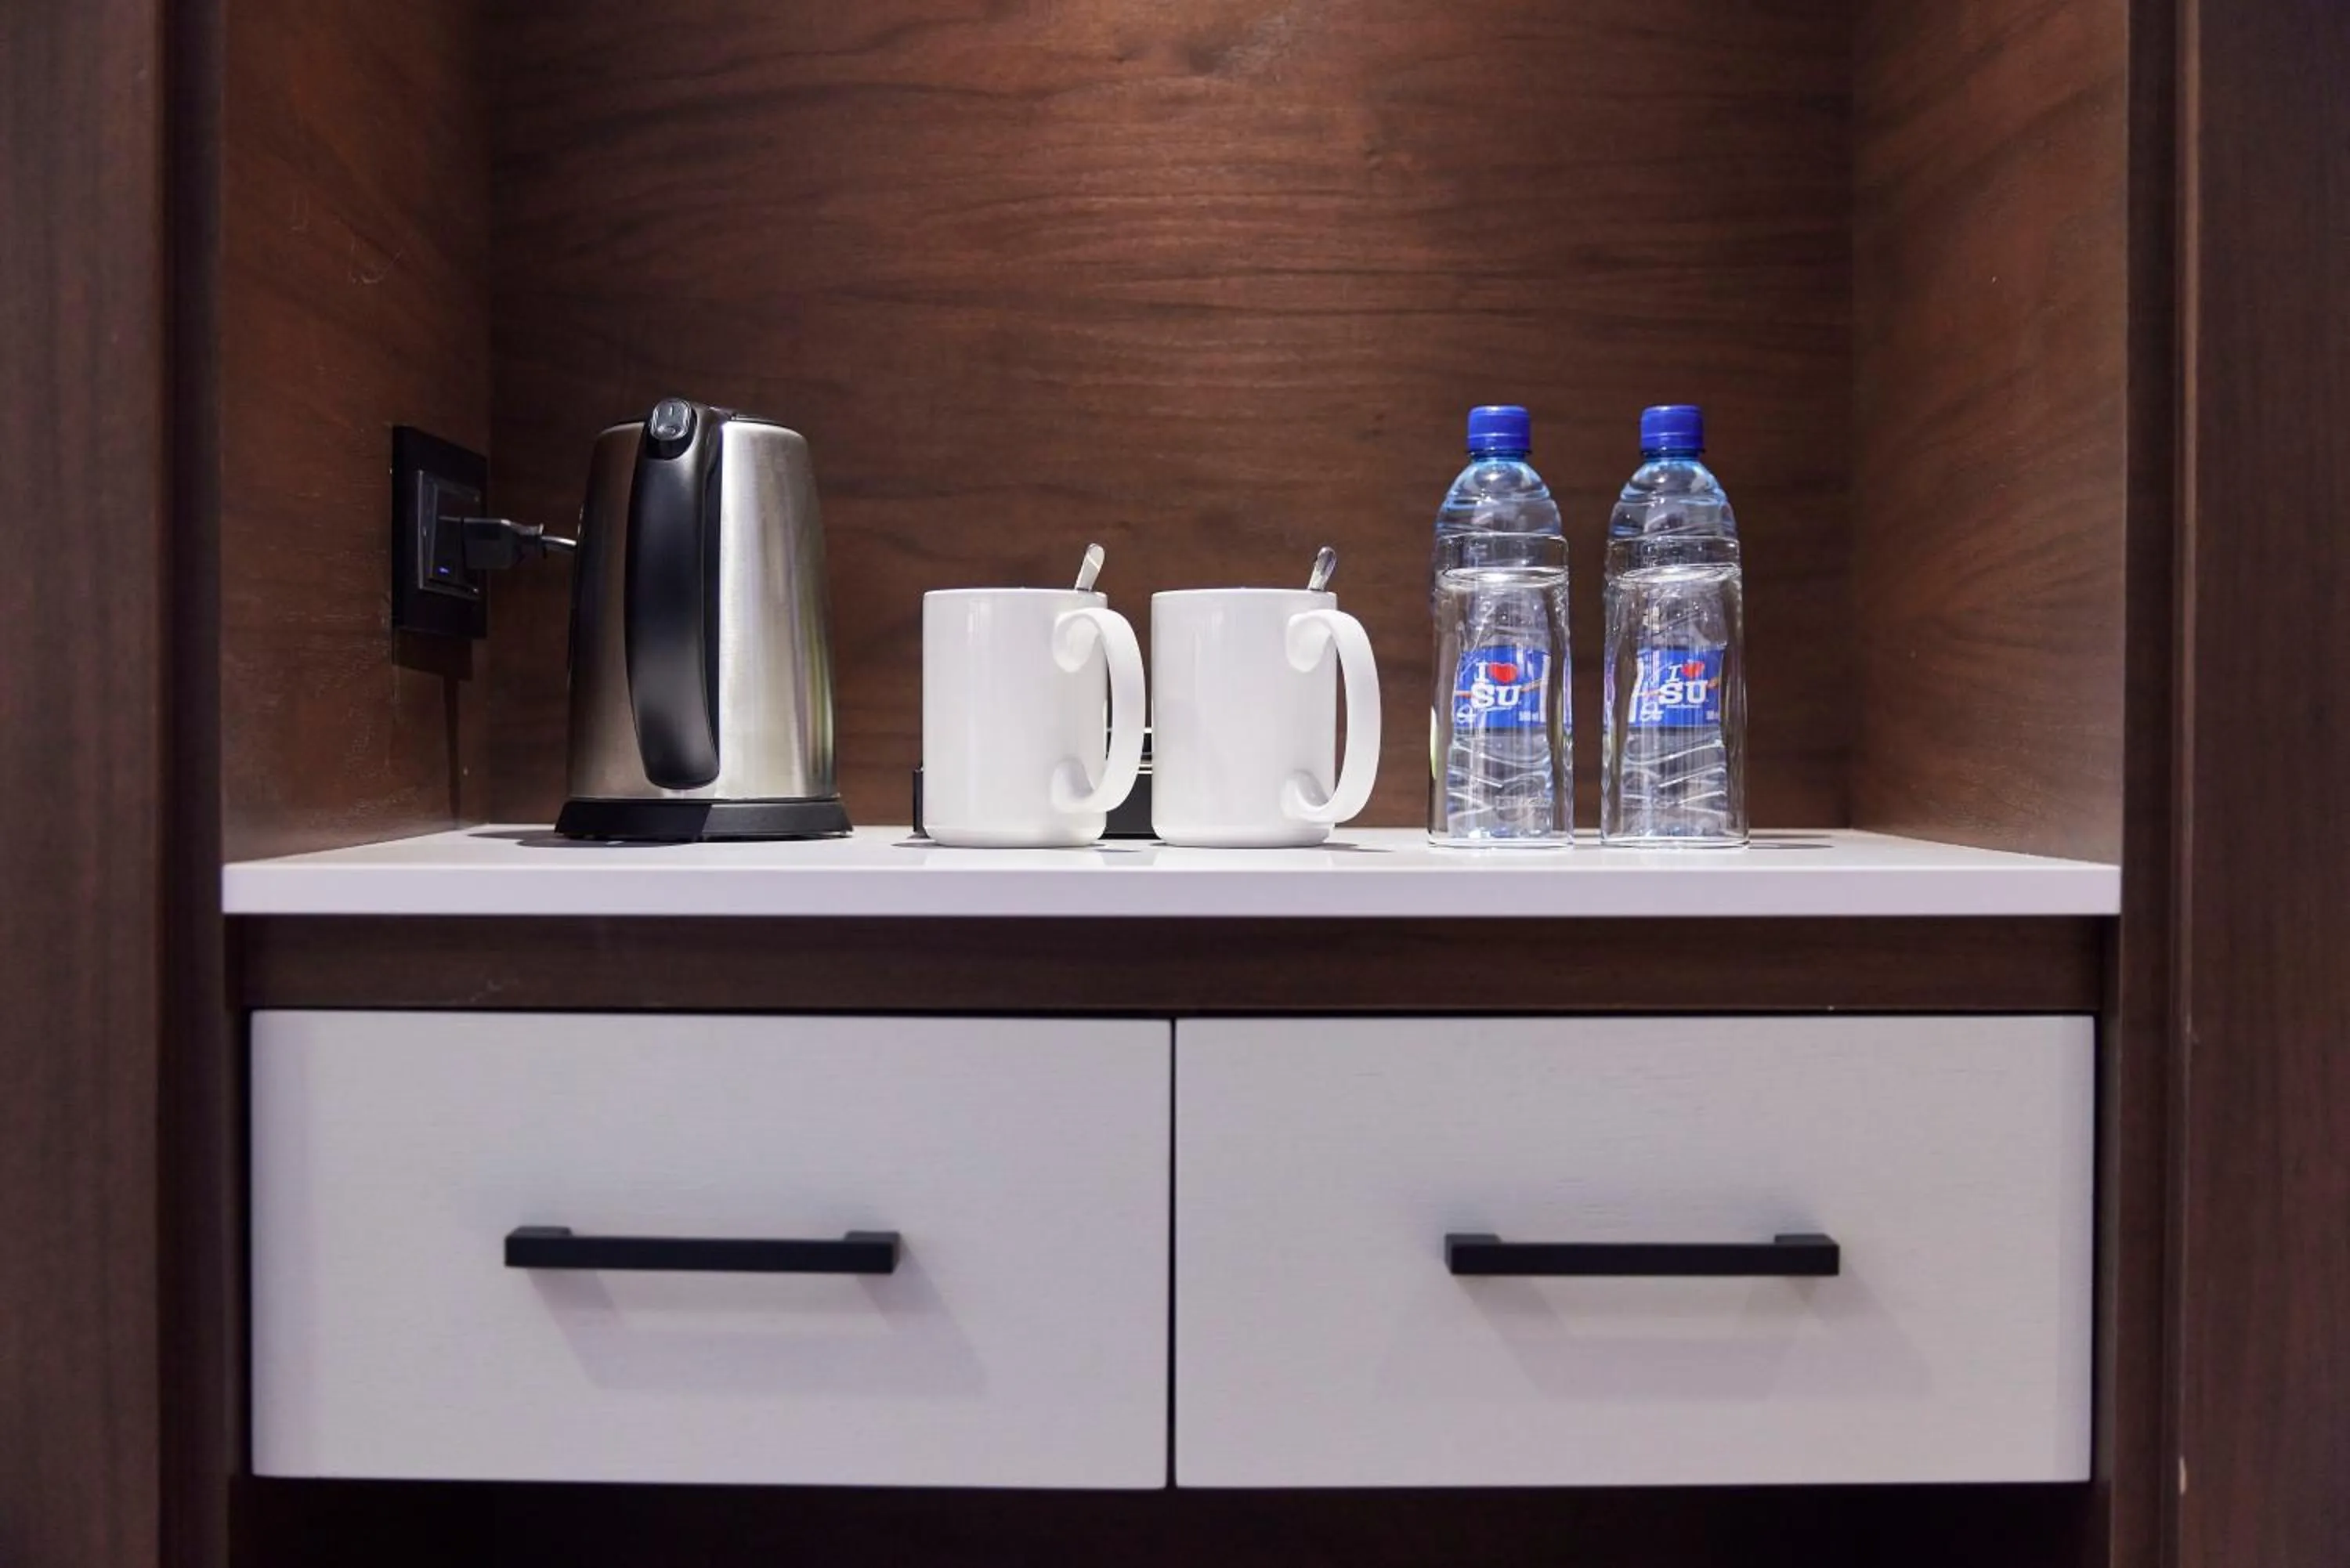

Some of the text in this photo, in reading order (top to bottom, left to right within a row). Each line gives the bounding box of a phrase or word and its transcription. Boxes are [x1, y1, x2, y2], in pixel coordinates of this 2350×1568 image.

[1474, 662, 1489, 683] I
[1665, 664, 1683, 683] I
[1471, 683, 1521, 708] SU
[1658, 680, 1708, 704] SU
